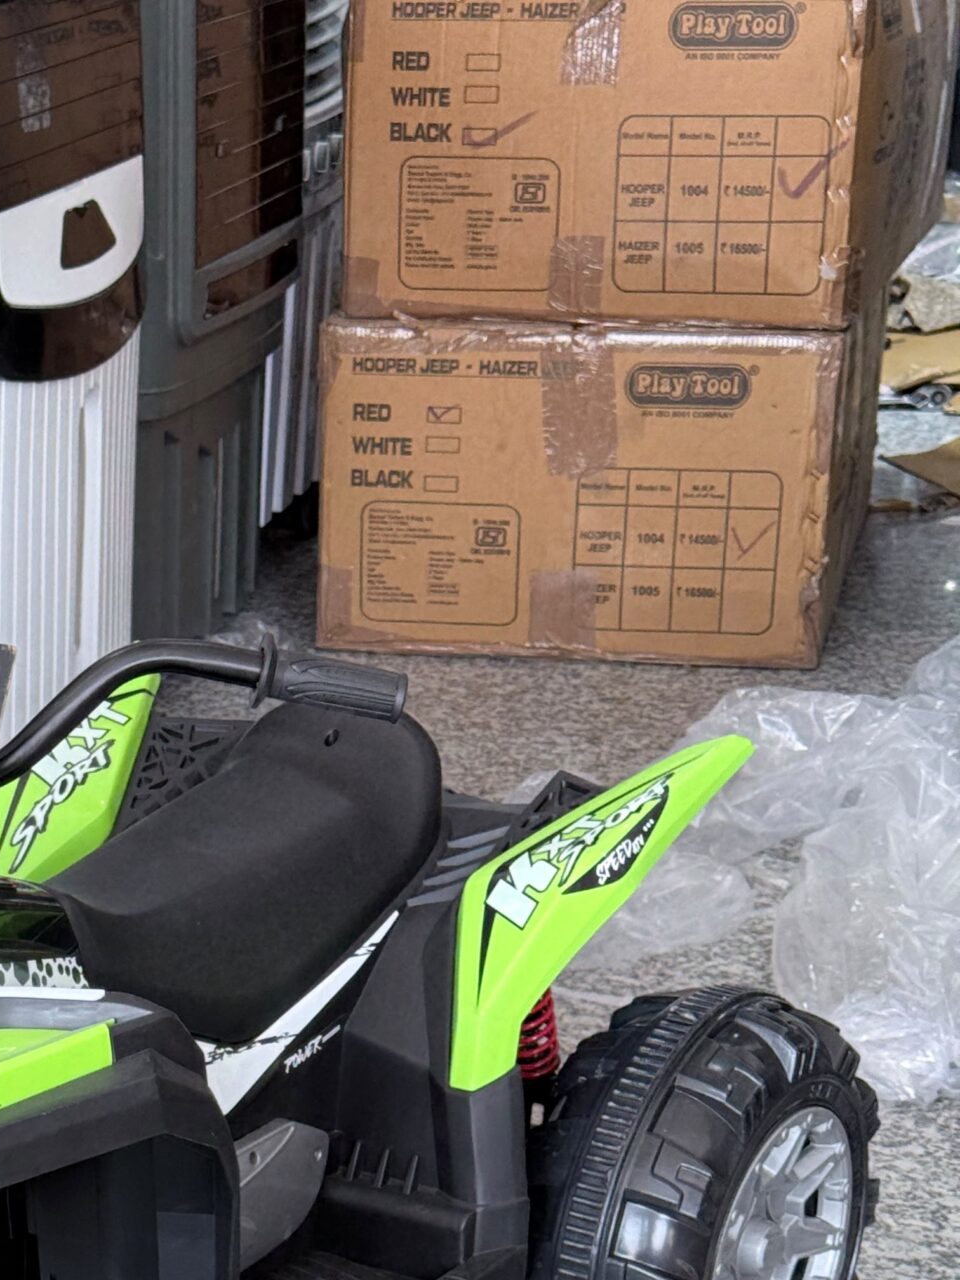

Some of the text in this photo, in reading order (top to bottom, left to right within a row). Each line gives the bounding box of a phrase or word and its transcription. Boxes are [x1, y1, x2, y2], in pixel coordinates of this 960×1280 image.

[391, 2, 456, 18] HOOPER
[459, 2, 501, 18] JEEP
[520, 2, 580, 18] HAIZER
[679, 12, 787, 40] Play Tool
[392, 51, 430, 71] RED
[390, 87, 452, 107] WHITE
[389, 122, 453, 142] BLACK
[620, 183, 665, 195] HOOPER
[680, 185, 709, 197] 1004
[628, 197, 656, 208] JEEP
[618, 240, 660, 252] HAIZER
[675, 242, 705, 255] 1005
[623, 254, 653, 265] JEEP
[352, 357, 417, 374] HOOPER
[419, 358, 460, 375] JEEP
[478, 360, 538, 377] HAIZER
[635, 372, 741, 399] Play Tool
[352, 402, 391, 422] RED
[352, 436, 413, 456] WHITE
[351, 468, 413, 489] BLACK
[579, 530, 622, 541] HOOPER
[636, 533, 665, 545] 1004
[587, 543, 613, 553] JEEP
[631, 585, 660, 597] 1005
[8, 738, 117, 875] SPORT
[557, 772, 675, 888] SPORT
[484, 813, 605, 931] KXT
[595, 838, 632, 886] SPEED
